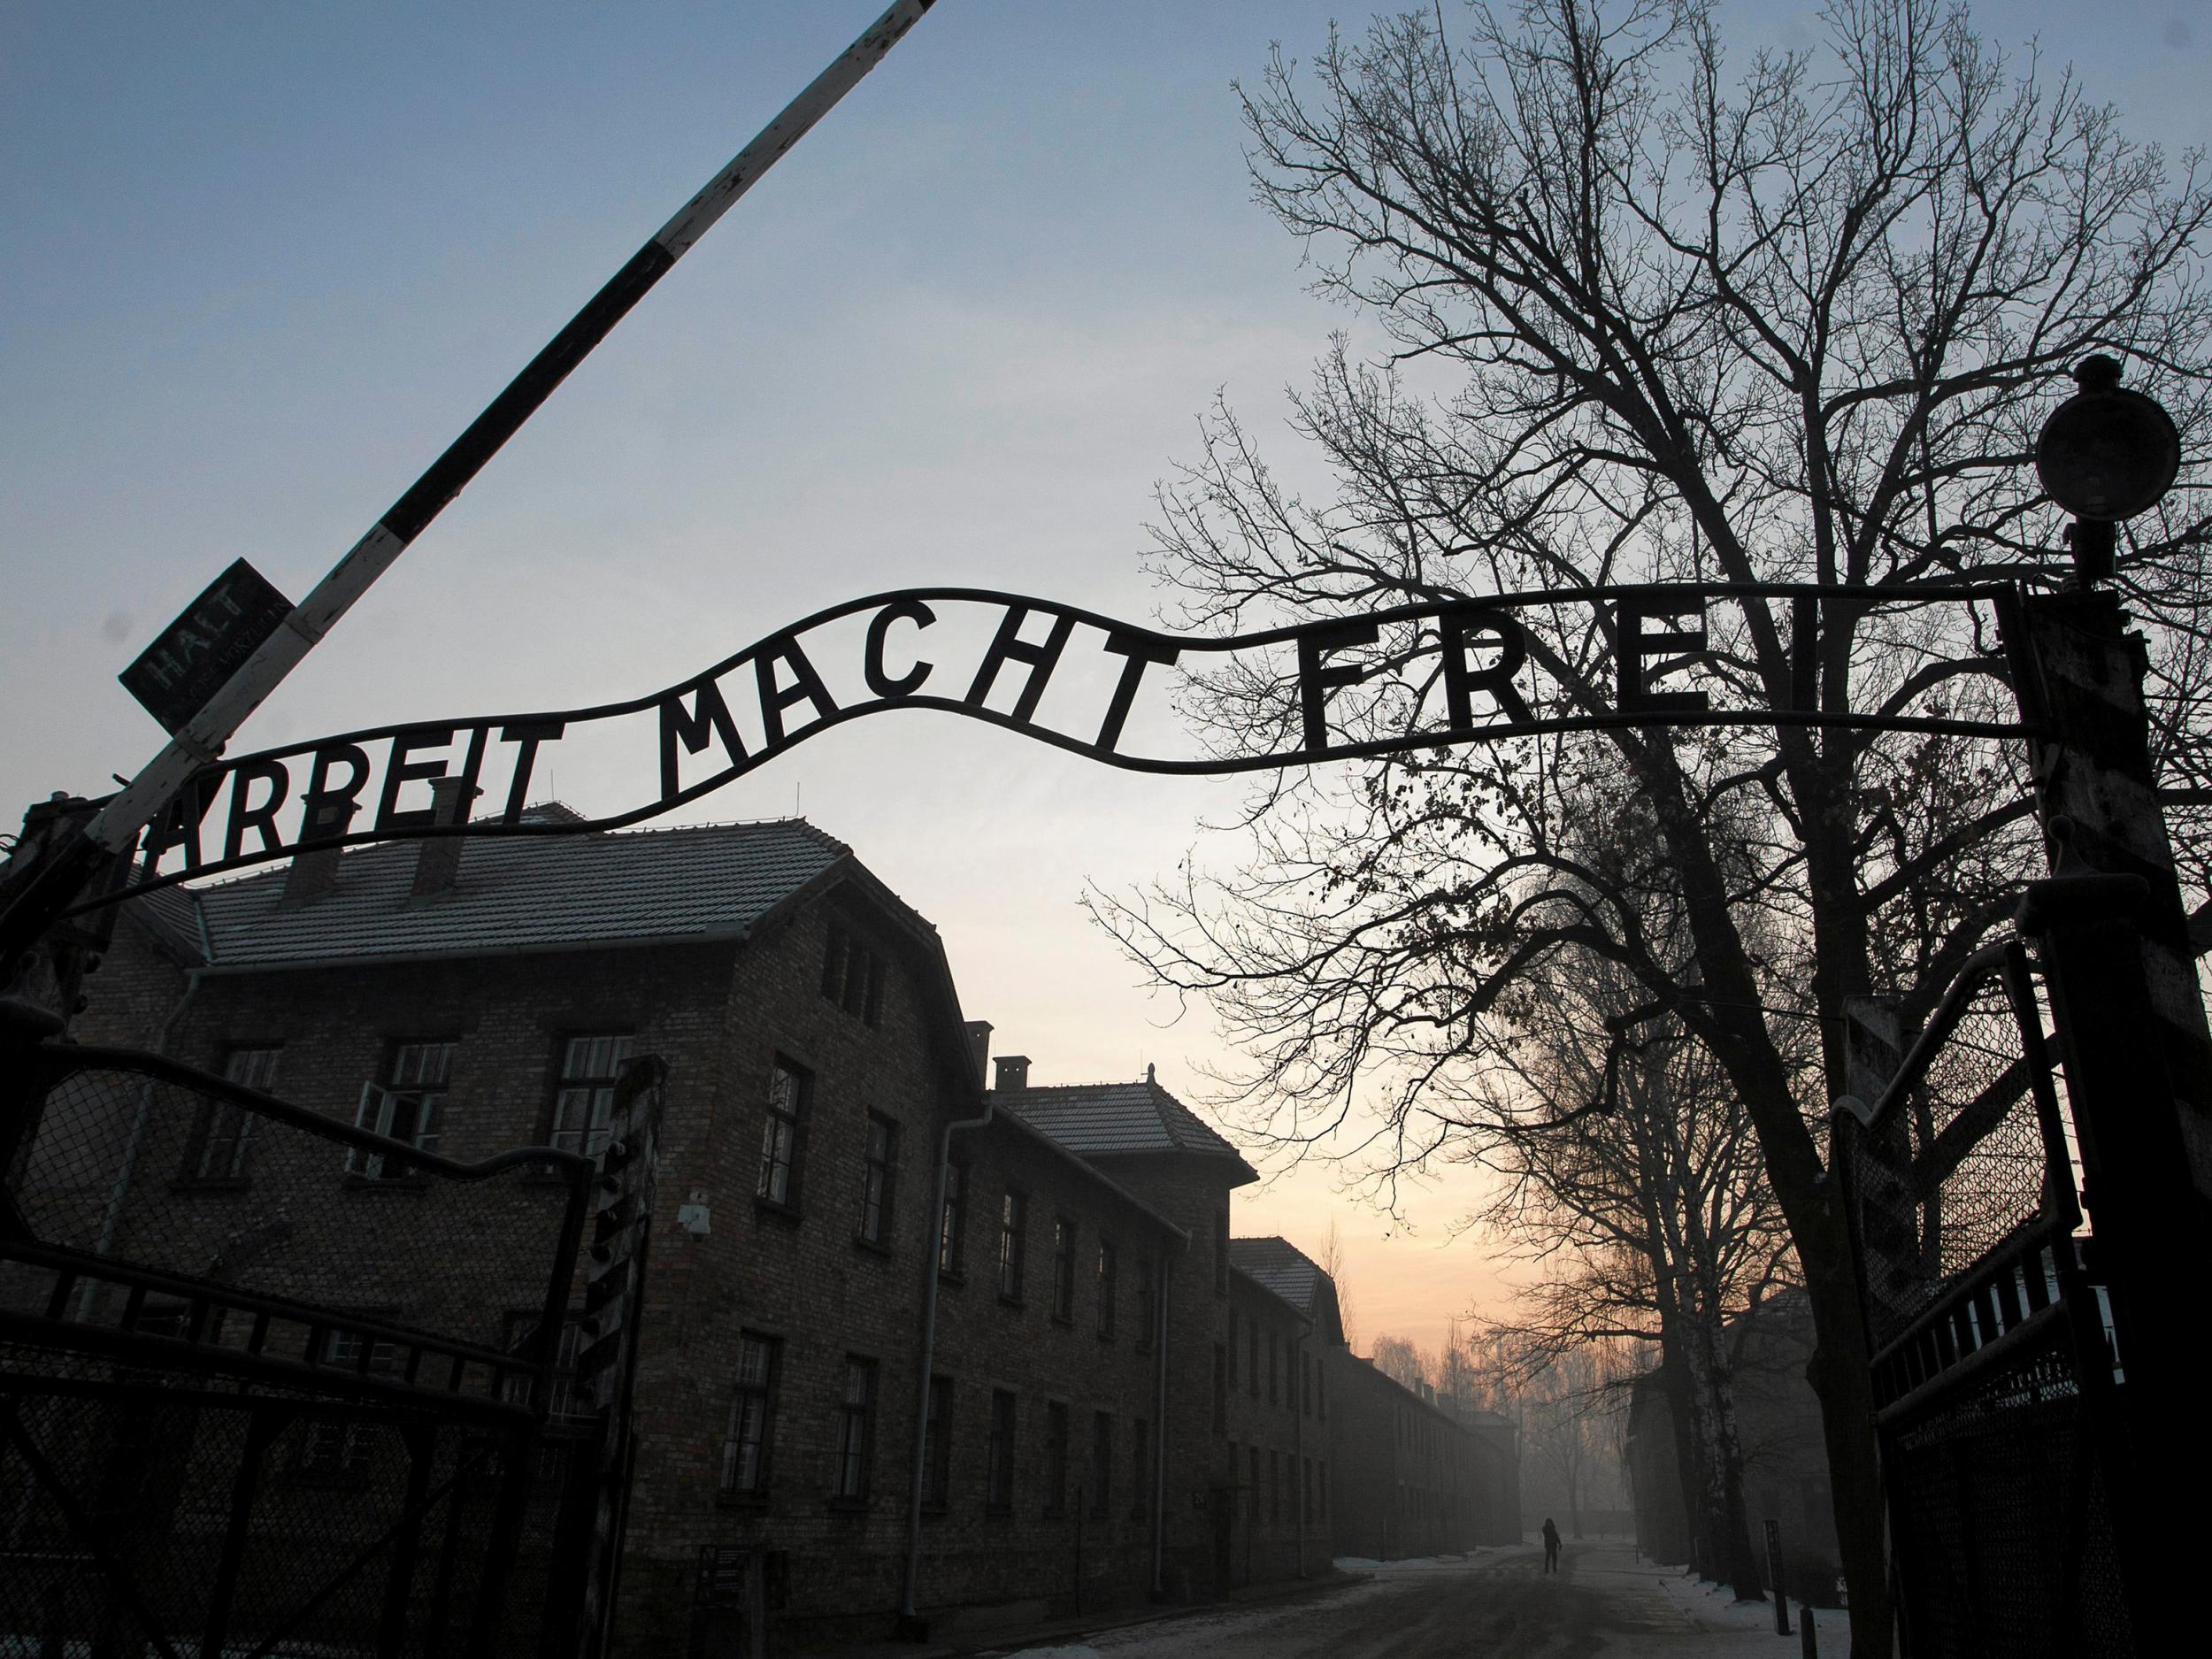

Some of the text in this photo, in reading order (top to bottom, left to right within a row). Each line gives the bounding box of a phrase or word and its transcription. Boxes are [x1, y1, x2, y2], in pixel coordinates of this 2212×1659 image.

[143, 584, 242, 690] HALT
[142, 595, 1817, 879] ARBEIT MACHT FREI
